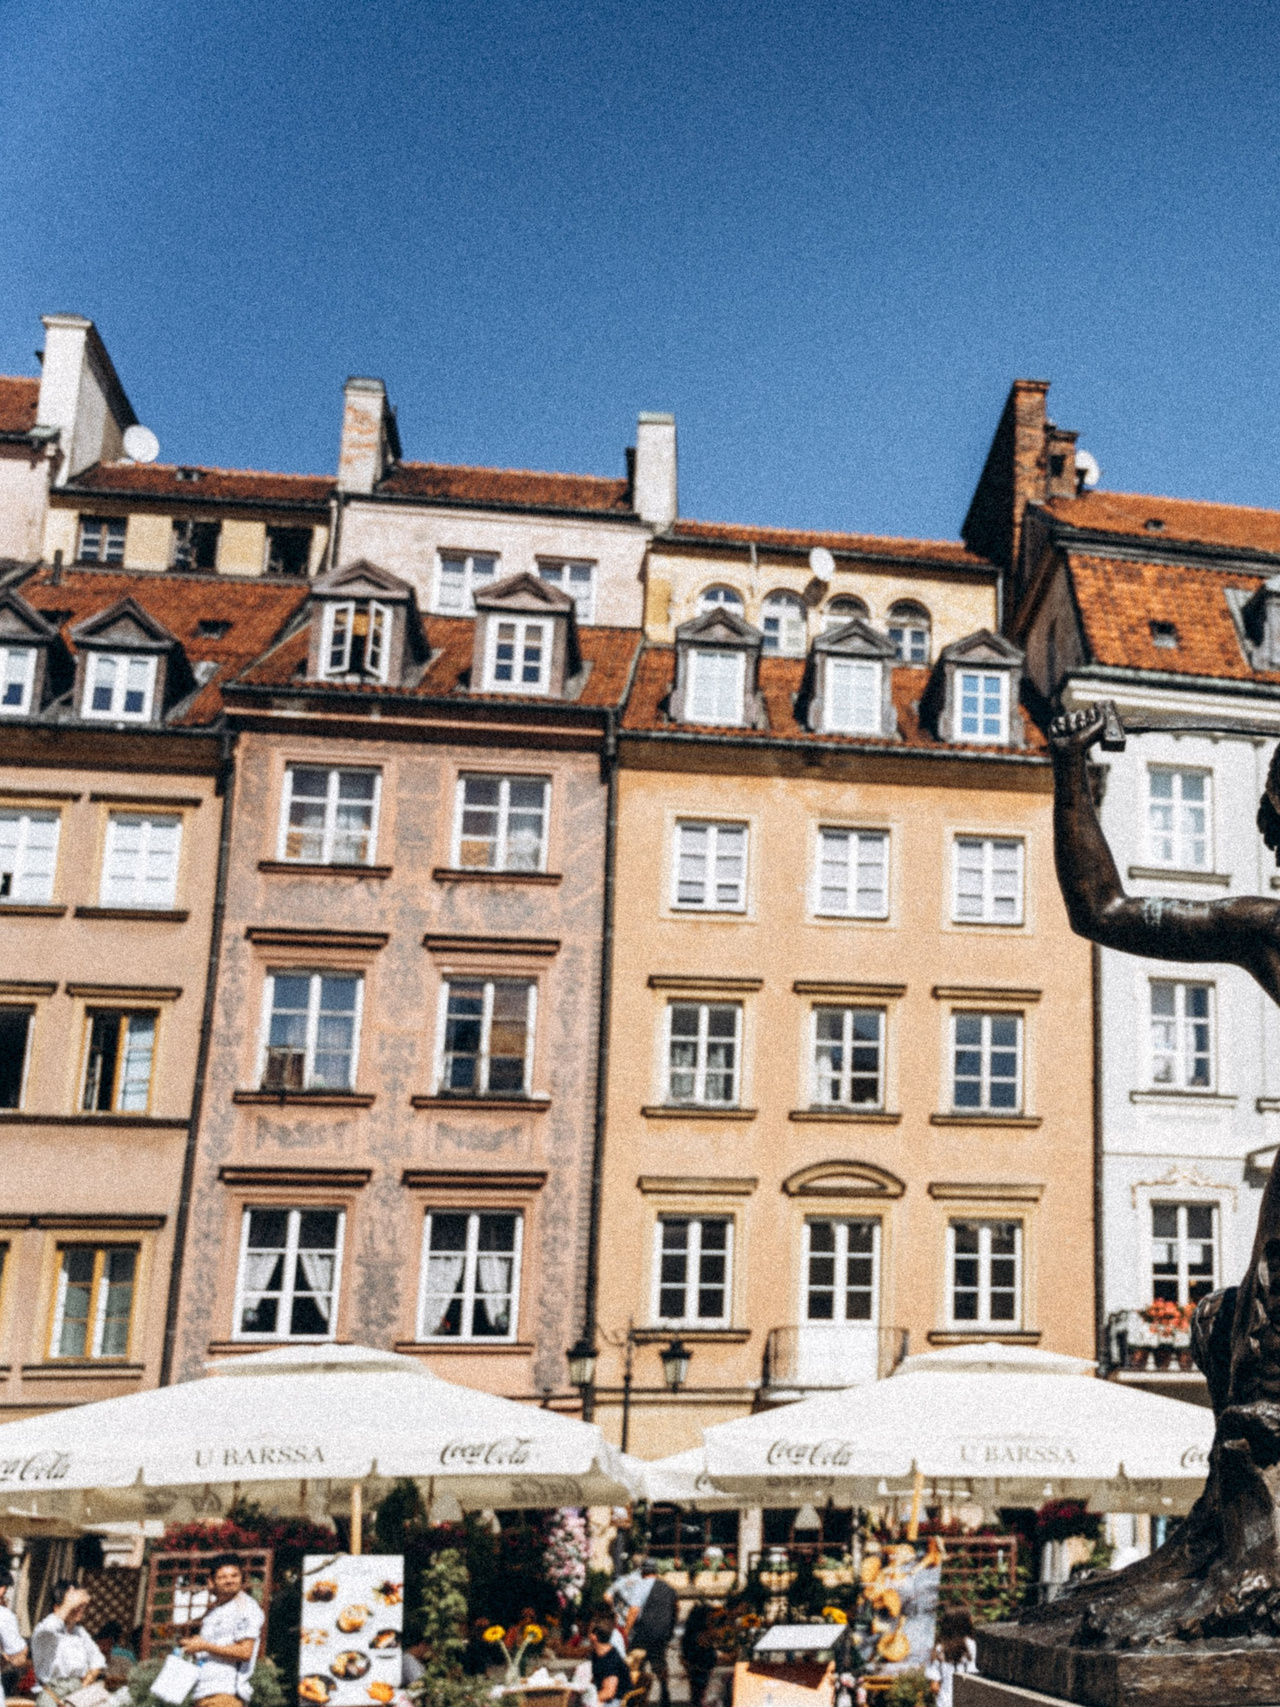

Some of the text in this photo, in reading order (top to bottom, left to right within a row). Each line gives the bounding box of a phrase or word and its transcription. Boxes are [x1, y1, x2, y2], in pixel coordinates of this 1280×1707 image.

[195, 1445, 325, 1468] U BARSSA
[960, 1445, 1076, 1464] U BARSSA
